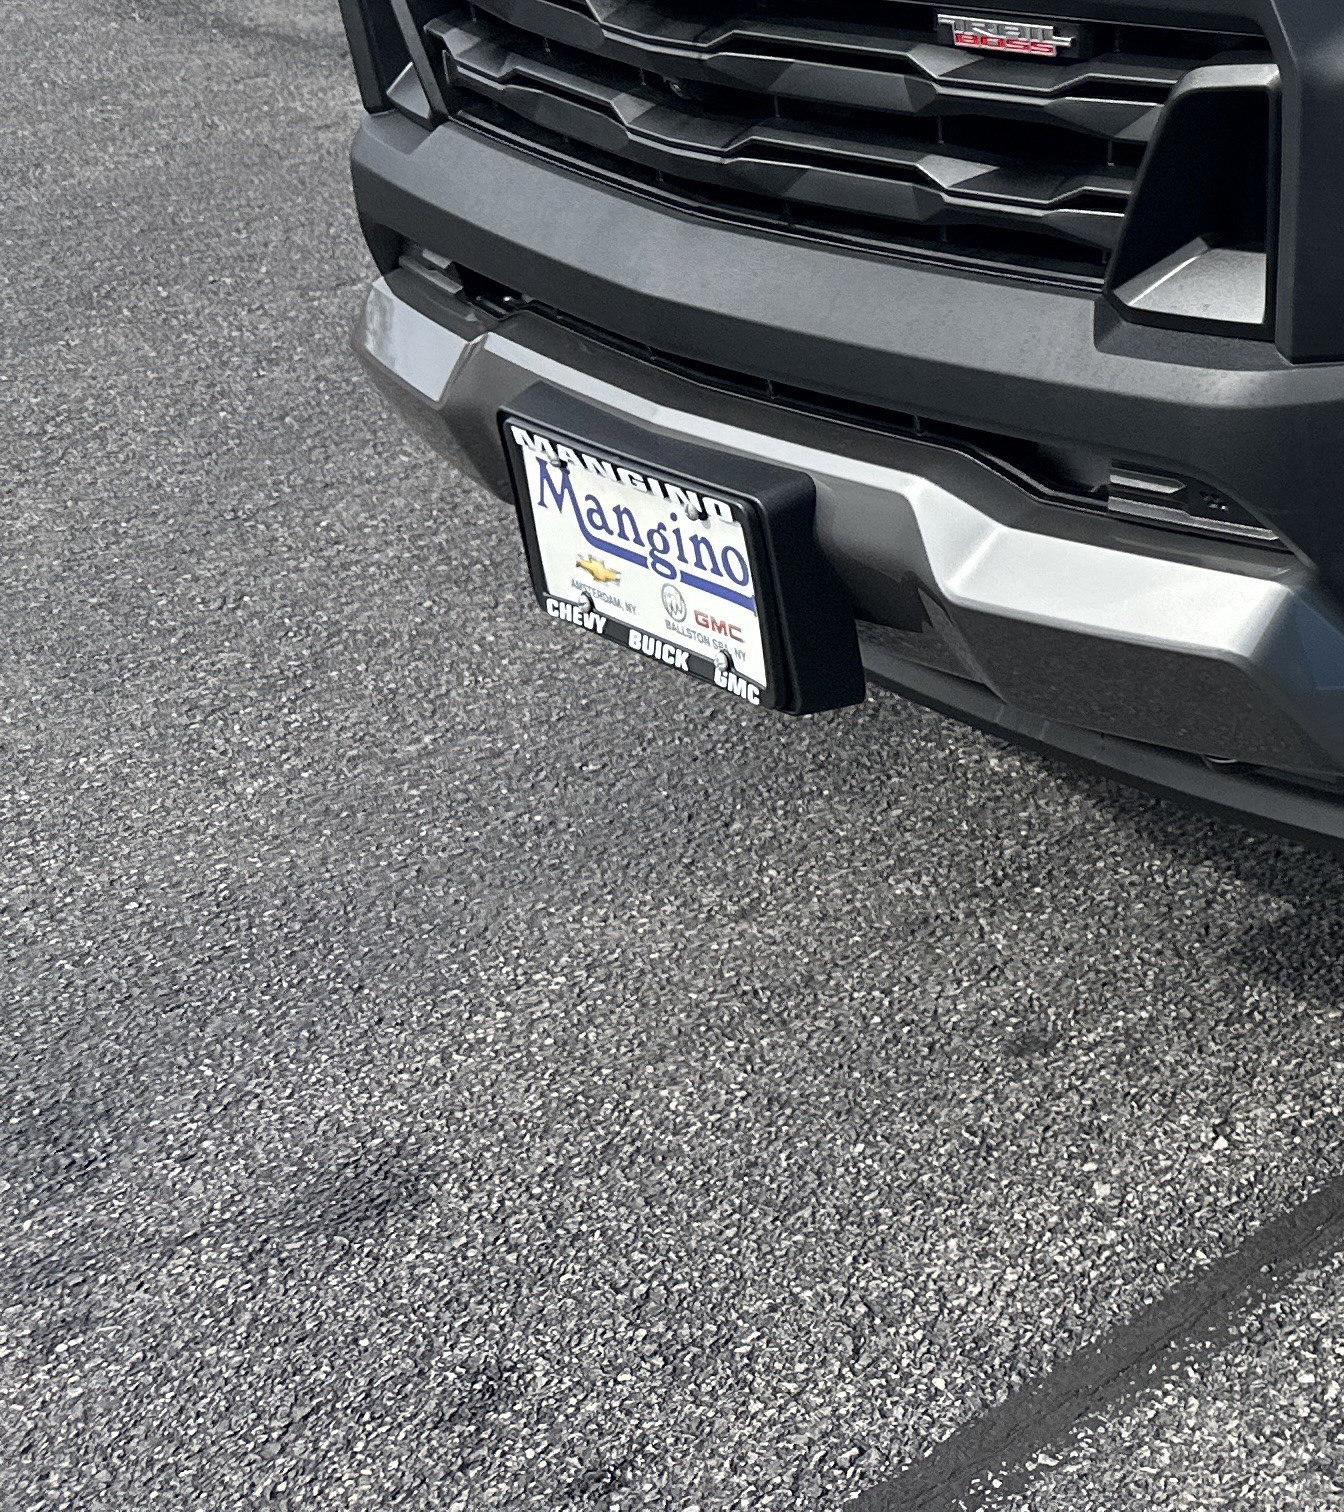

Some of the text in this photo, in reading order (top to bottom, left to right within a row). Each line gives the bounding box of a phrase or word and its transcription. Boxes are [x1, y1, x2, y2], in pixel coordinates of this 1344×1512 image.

[954, 32, 1057, 57] BOSS
[510, 425, 735, 523] MANGINO
[535, 455, 754, 592] Mangino
[625, 601, 637, 615] NY
[693, 609, 746, 644] GMC
[545, 597, 761, 706] CHEVY BUICK GMC
[664, 619, 711, 647] BALLSTON
[734, 647, 747, 662] NY
